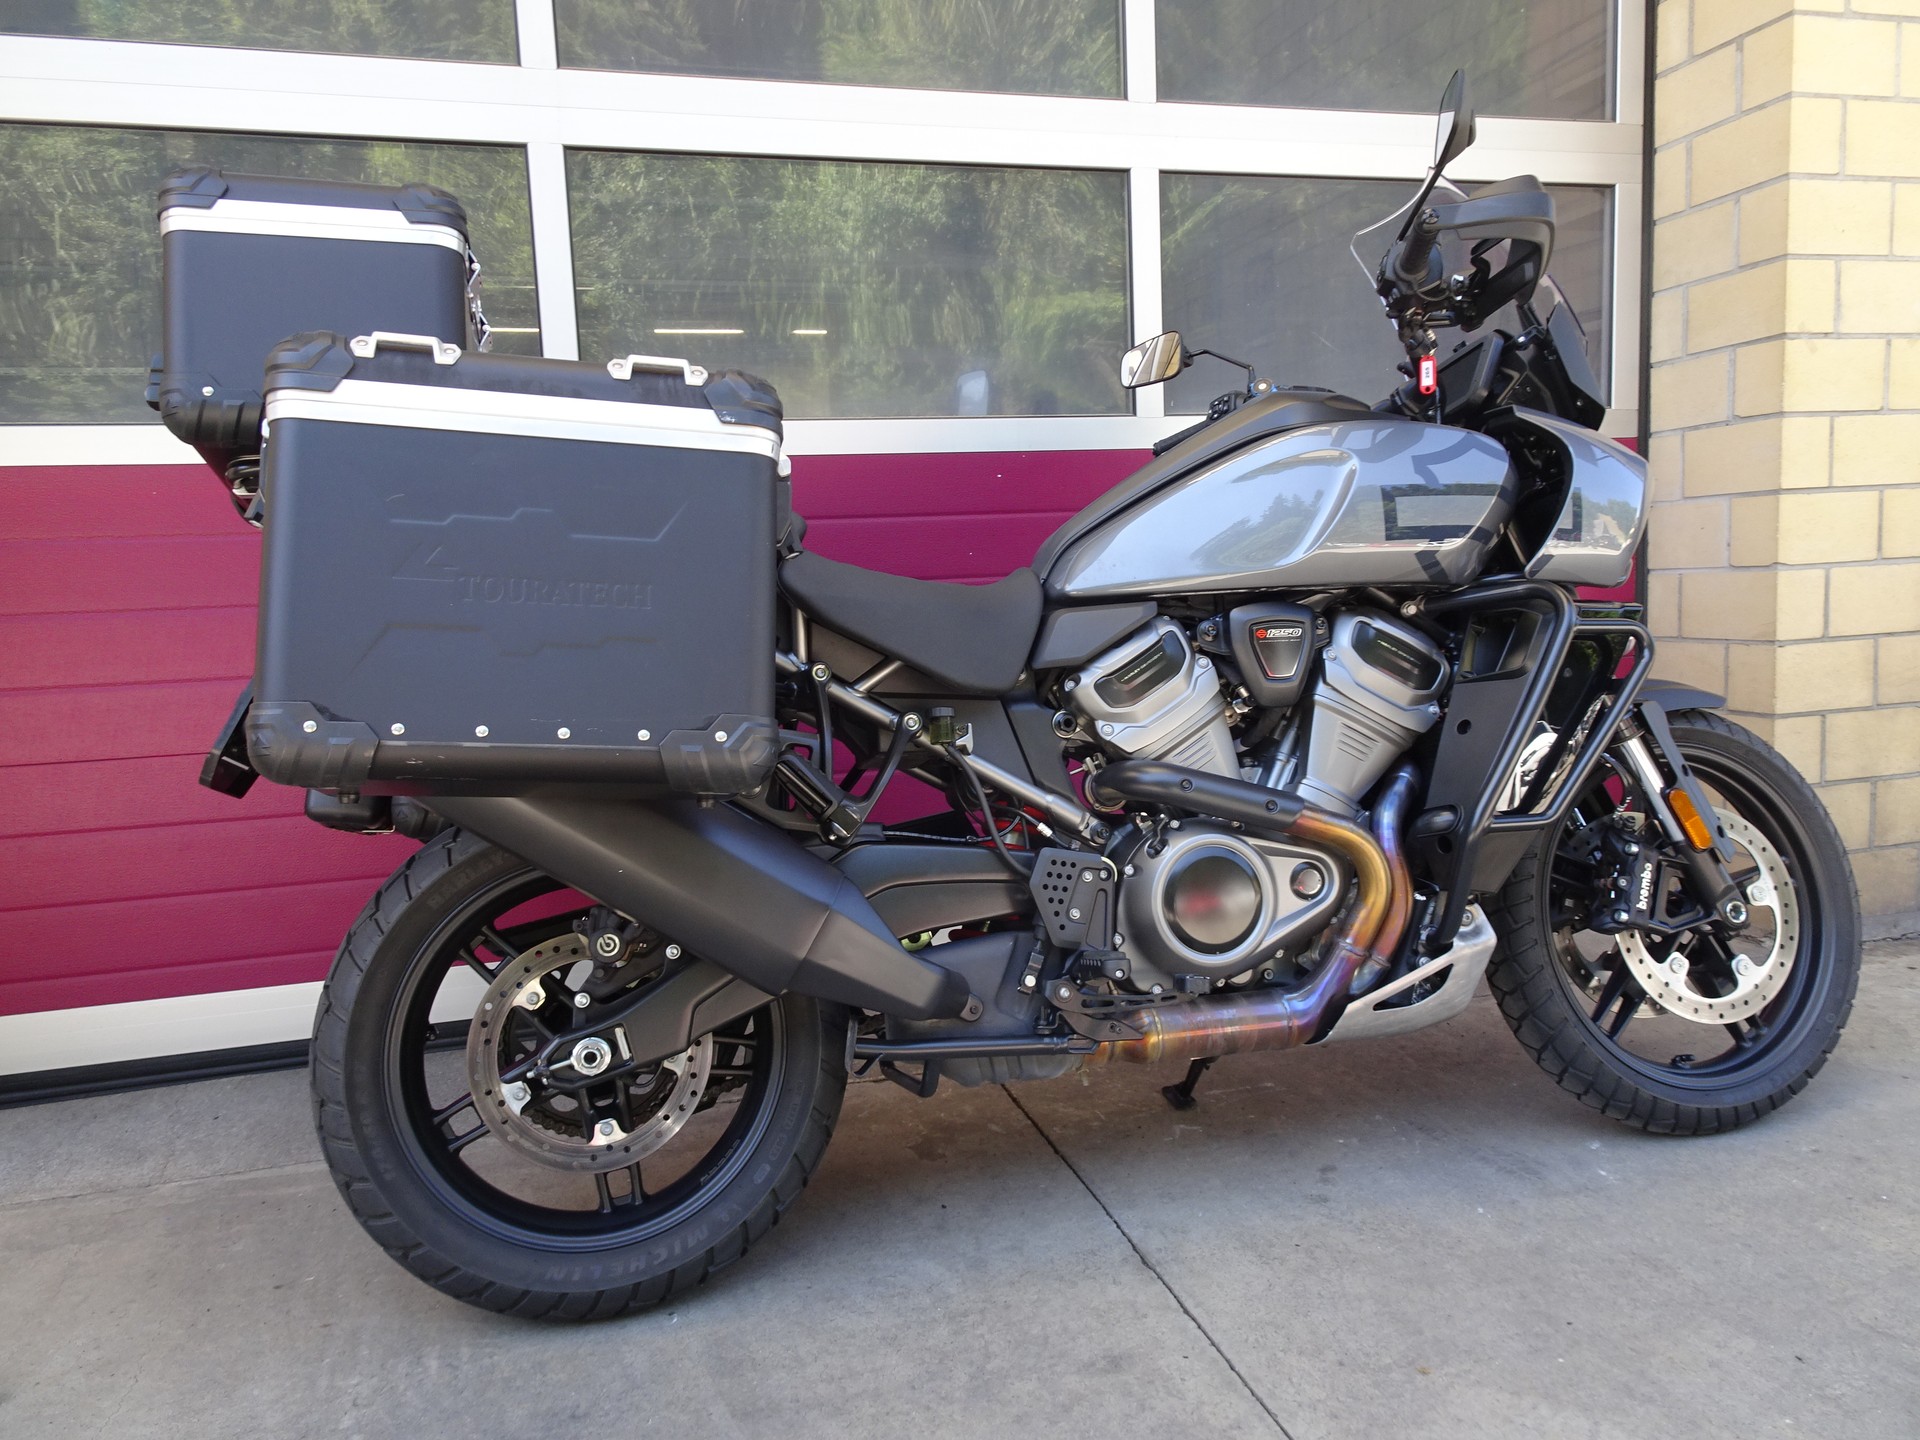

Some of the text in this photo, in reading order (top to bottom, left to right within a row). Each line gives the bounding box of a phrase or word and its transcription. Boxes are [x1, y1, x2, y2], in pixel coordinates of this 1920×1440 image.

[457, 574, 652, 609] TOURATECH
[1266, 628, 1302, 637] 1250
[1636, 862, 1652, 910] brembo
[544, 1224, 711, 1281] MICHELIN
